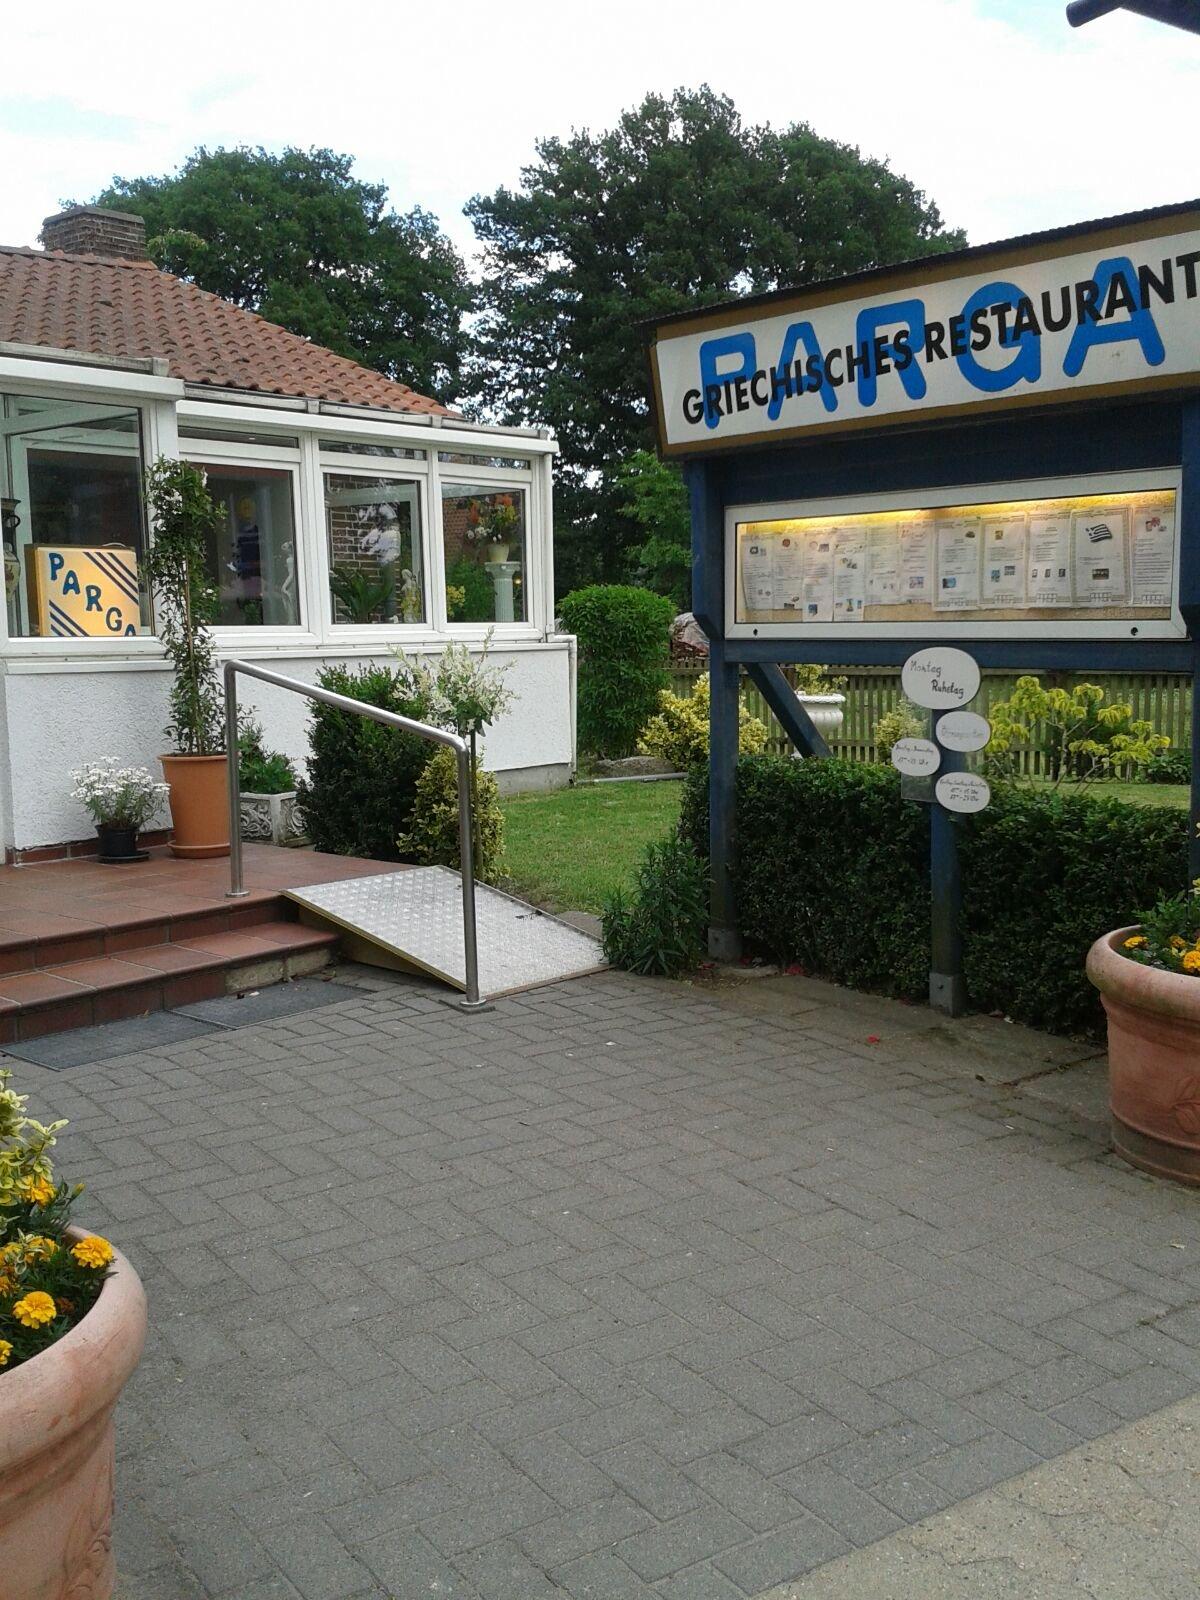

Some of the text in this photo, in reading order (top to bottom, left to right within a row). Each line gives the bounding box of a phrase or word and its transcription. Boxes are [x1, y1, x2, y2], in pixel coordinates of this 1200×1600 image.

[682, 250, 1200, 424] GRIECHISCHES RESTAURANT
[699, 256, 1166, 429] PARGA
[910, 660, 942, 678] Montag
[931, 678, 965, 699] Ruhetag
